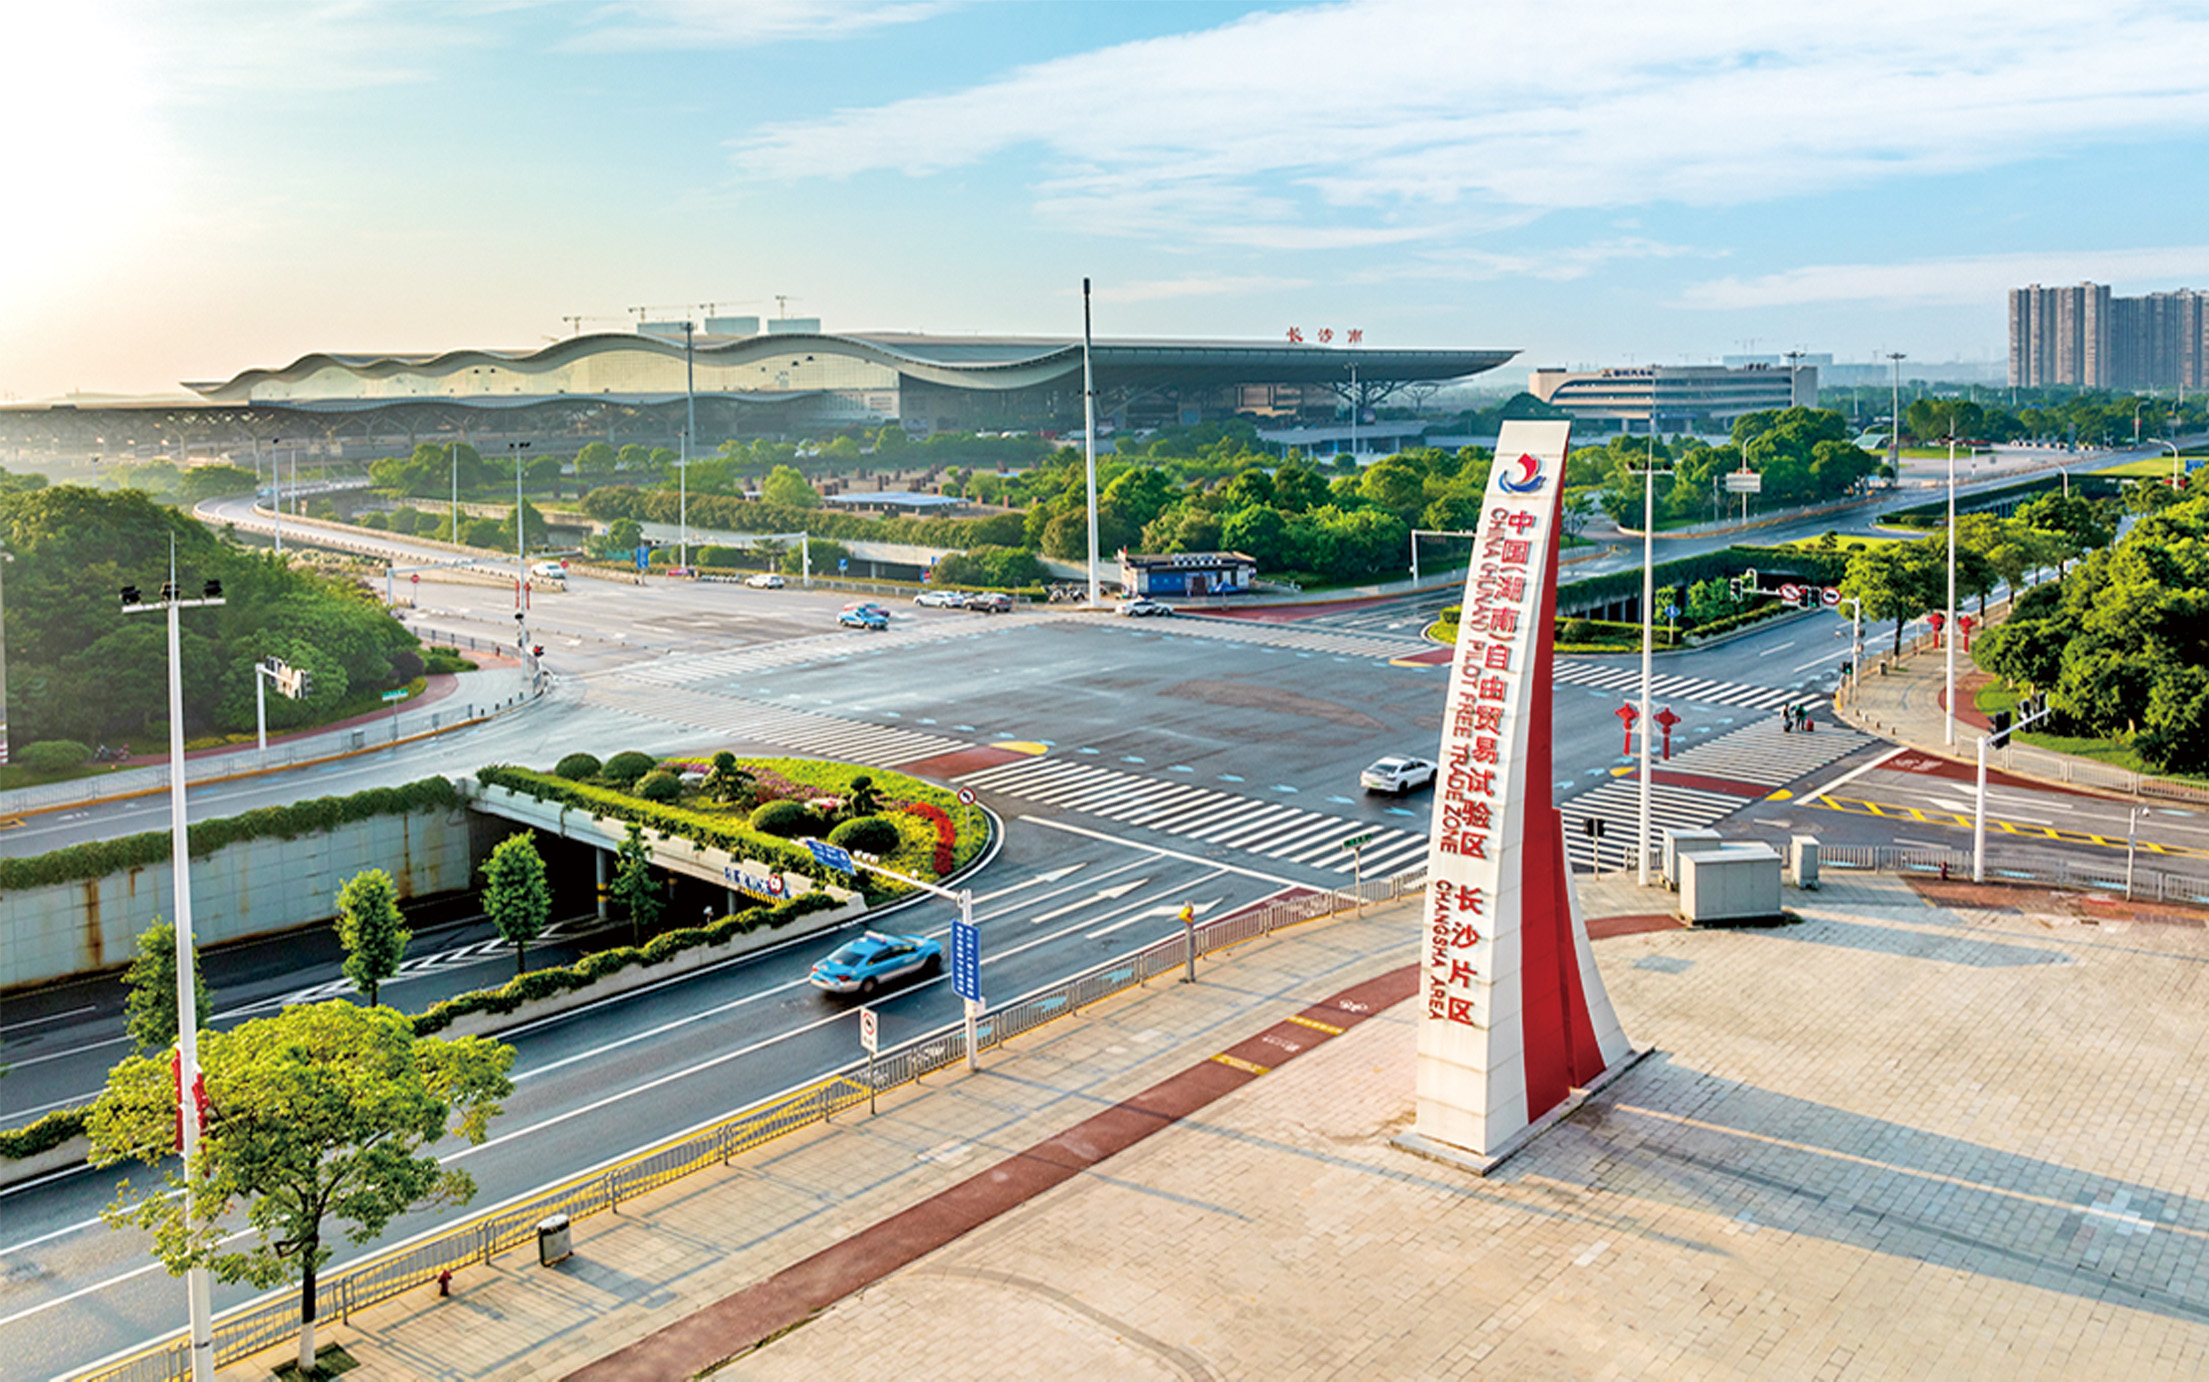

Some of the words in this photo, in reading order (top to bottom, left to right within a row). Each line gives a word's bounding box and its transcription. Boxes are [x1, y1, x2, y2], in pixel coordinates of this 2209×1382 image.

[1482, 507, 1508, 558] CHINA
[1470, 562, 1498, 632] (HUNAN)
[1461, 639, 1485, 689] PILOT
[1453, 691, 1476, 738] FREE
[1445, 744, 1470, 801] TRADE
[1440, 804, 1462, 854] ZONE
[1431, 879, 1451, 968] CHANGSHA
[1428, 975, 1446, 1020] AREA
